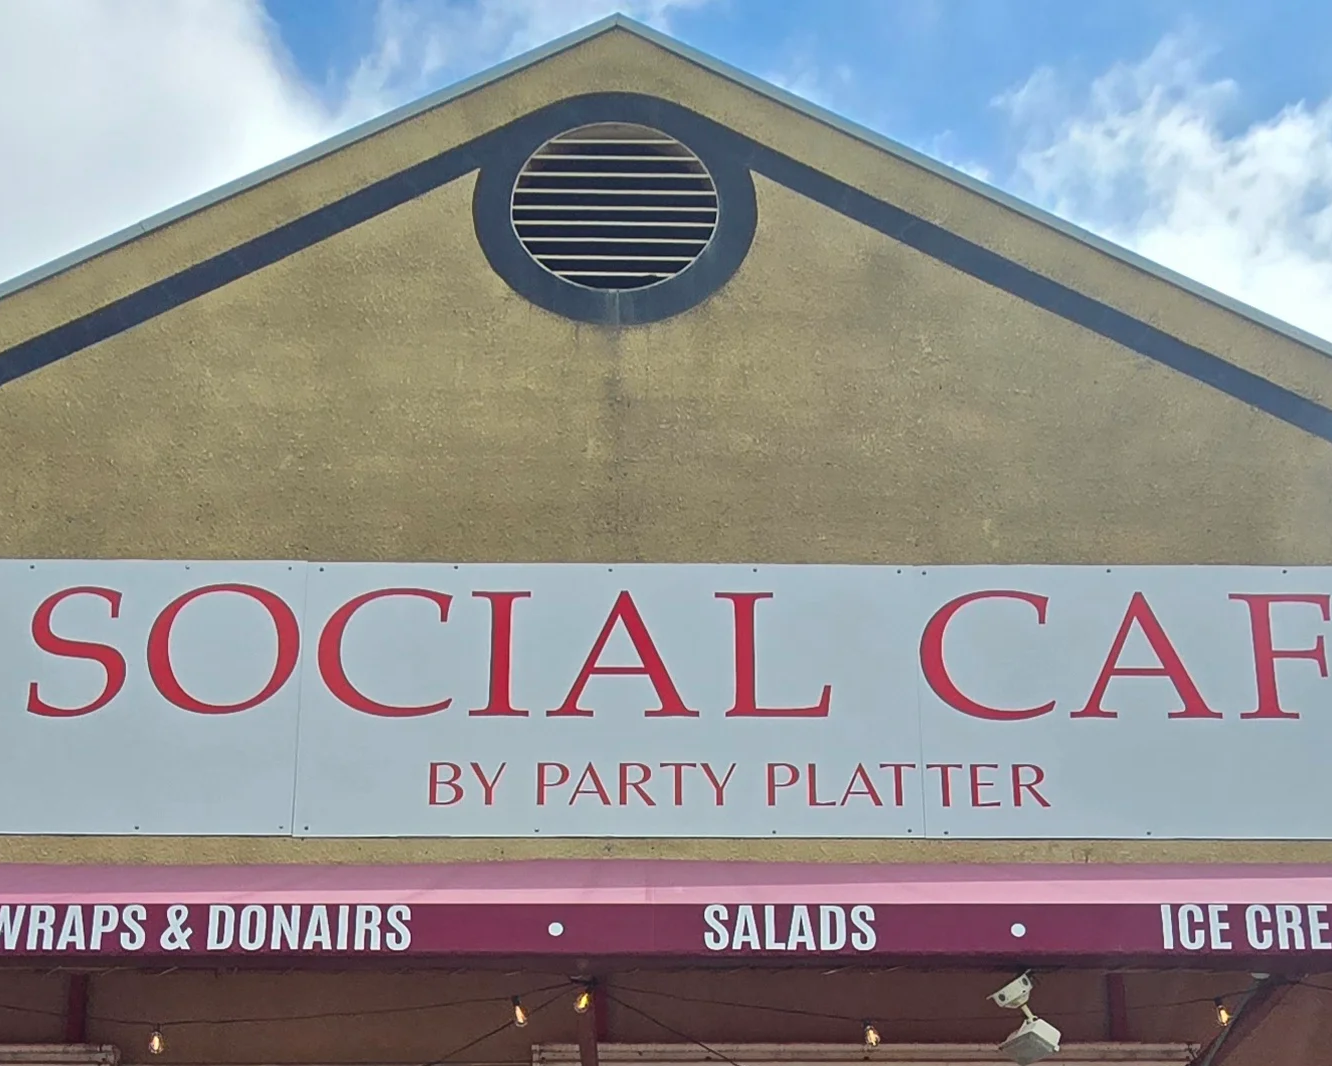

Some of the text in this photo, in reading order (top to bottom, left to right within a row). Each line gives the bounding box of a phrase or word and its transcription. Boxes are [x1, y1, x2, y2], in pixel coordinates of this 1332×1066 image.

[26, 583, 831, 717] SOCIAL
[428, 761, 1051, 807] BY PARTY PLATTER
[159, 905, 193, 950] &
[207, 904, 411, 951] DONAIRS
[703, 904, 877, 951] SALADS
[1160, 903, 1232, 950] ICE
